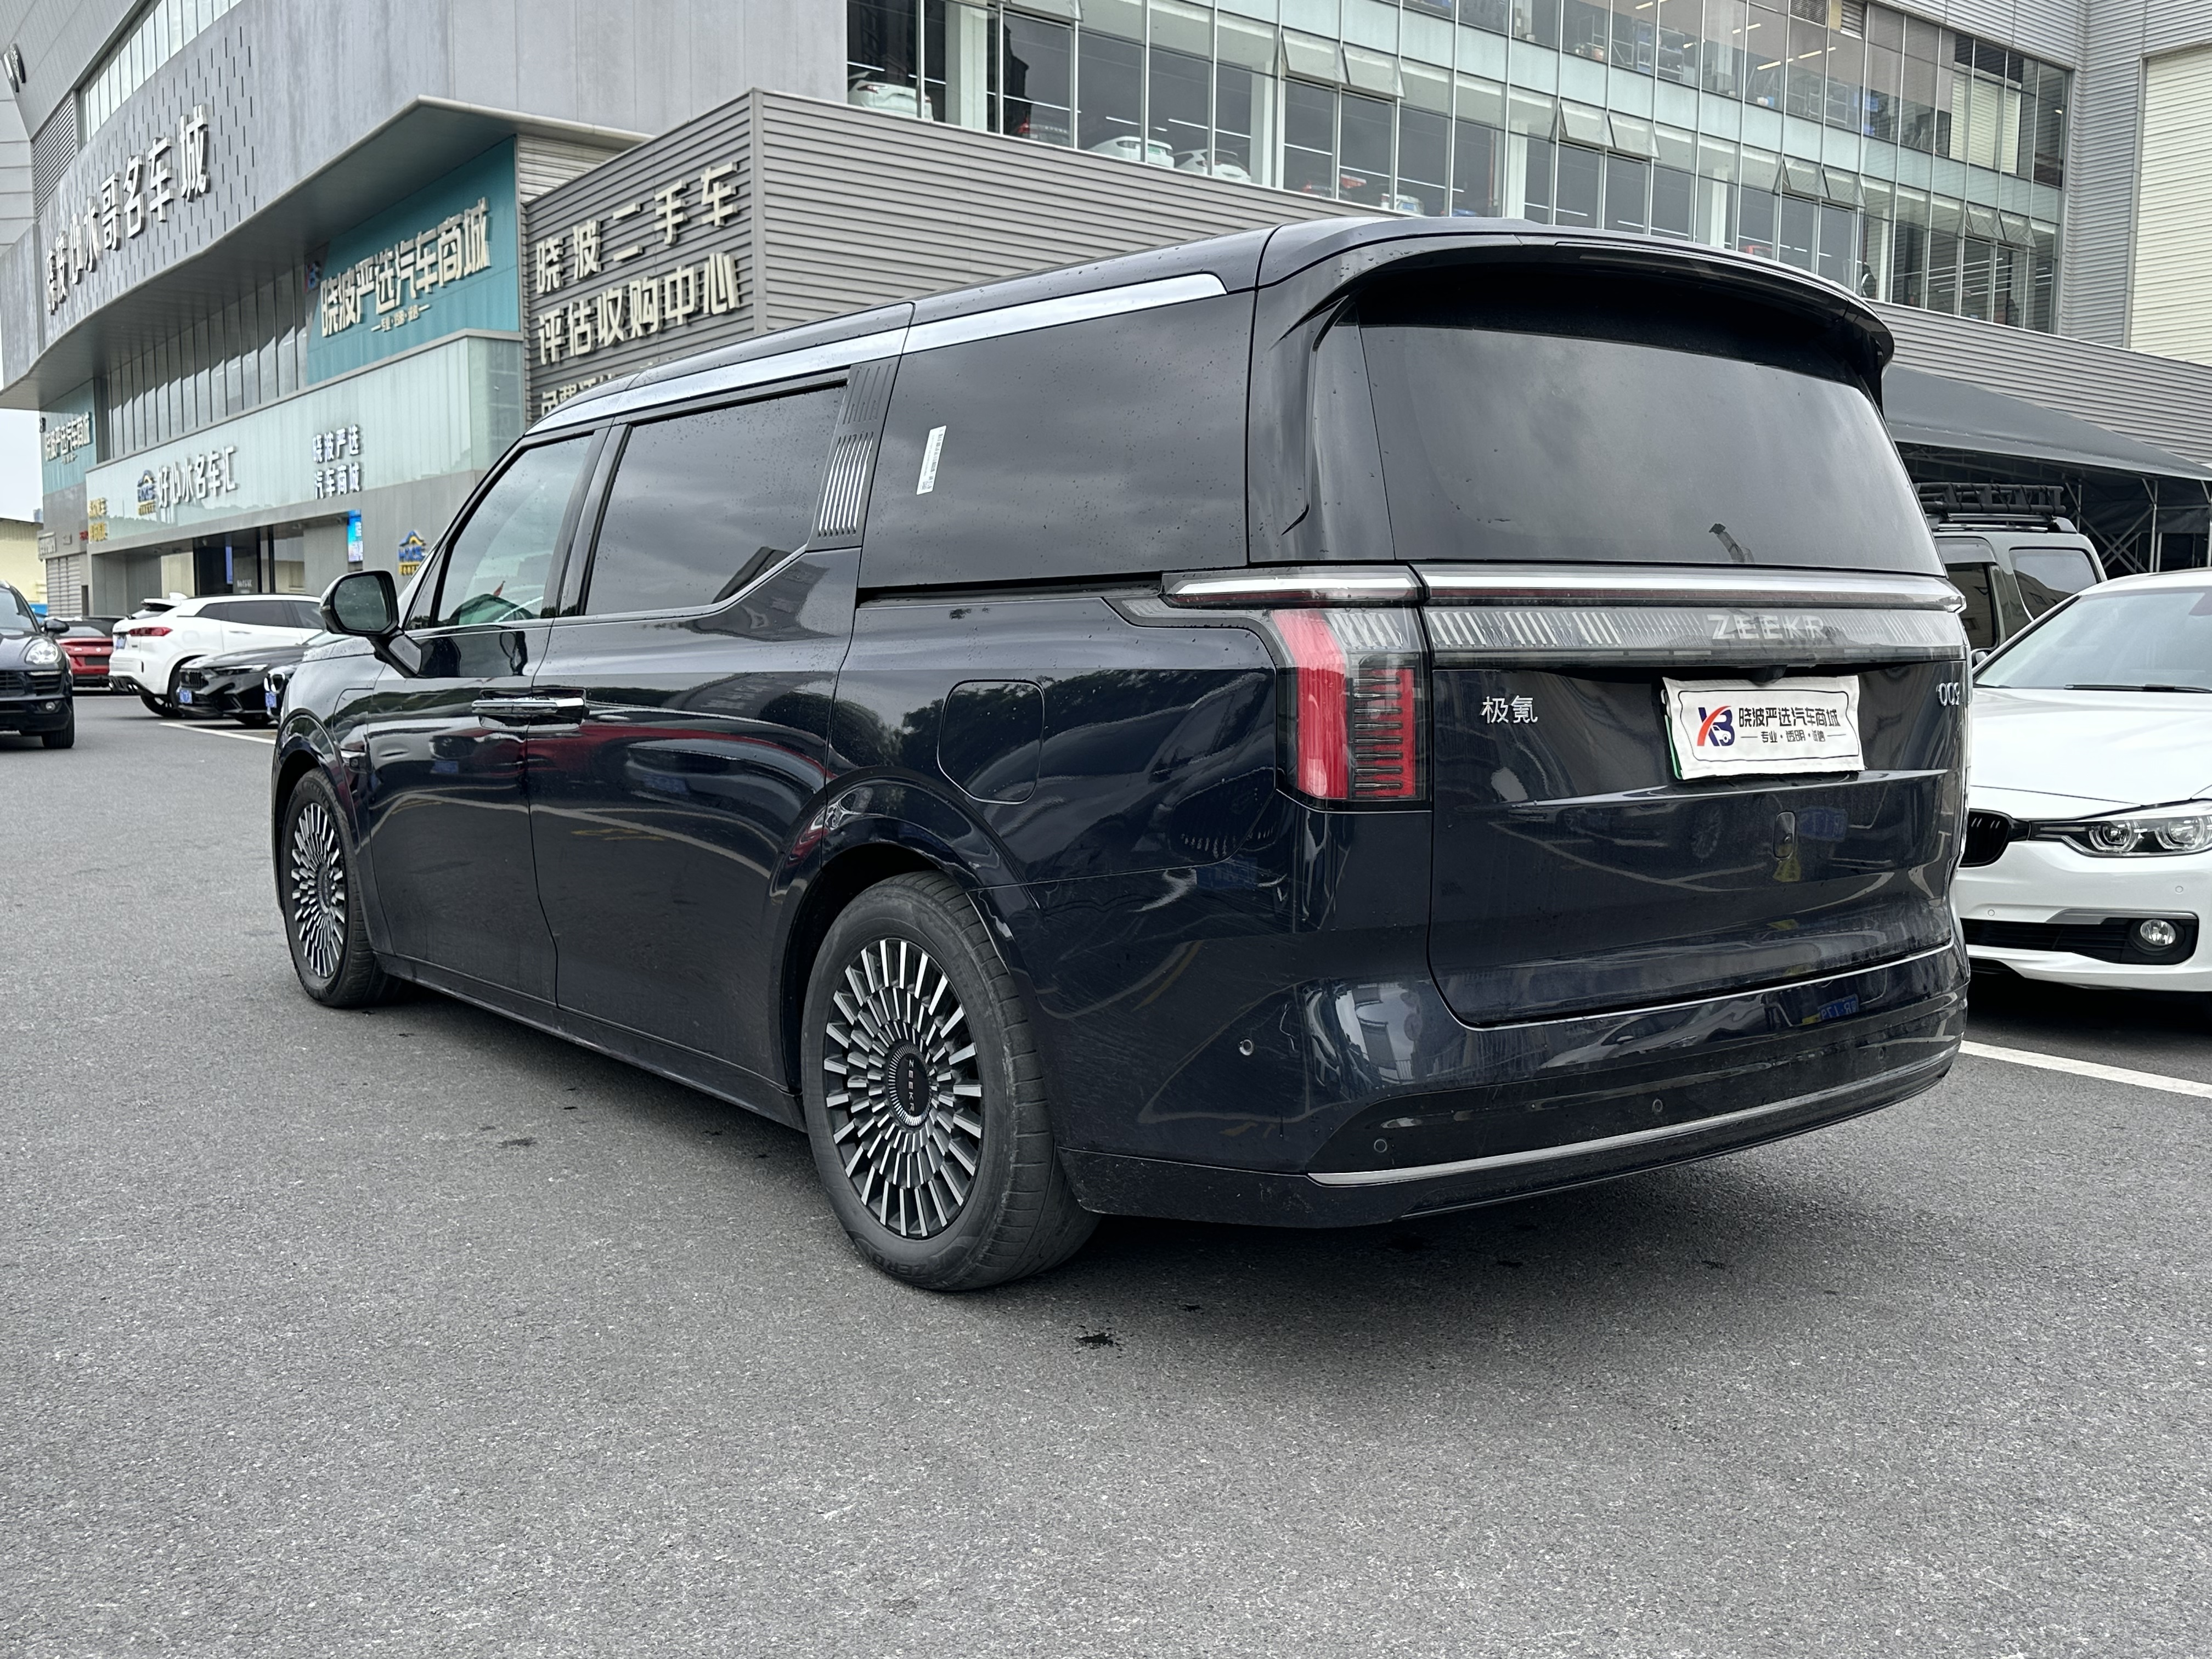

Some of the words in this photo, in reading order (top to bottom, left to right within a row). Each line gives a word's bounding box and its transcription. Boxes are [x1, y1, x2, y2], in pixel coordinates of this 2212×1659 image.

[536, 161, 738, 294] 晓波二手车
[320, 196, 491, 338] 晓波严选汽车商城
[538, 252, 740, 365] 评估收购中心
[158, 445, 238, 508] 好心水名车汇
[314, 461, 360, 500] 汽车商城
[1707, 614, 1828, 640] ZEEKR
[1481, 695, 1538, 724] 极氪
[1739, 707, 1841, 727] 晓波严选汽车商城
